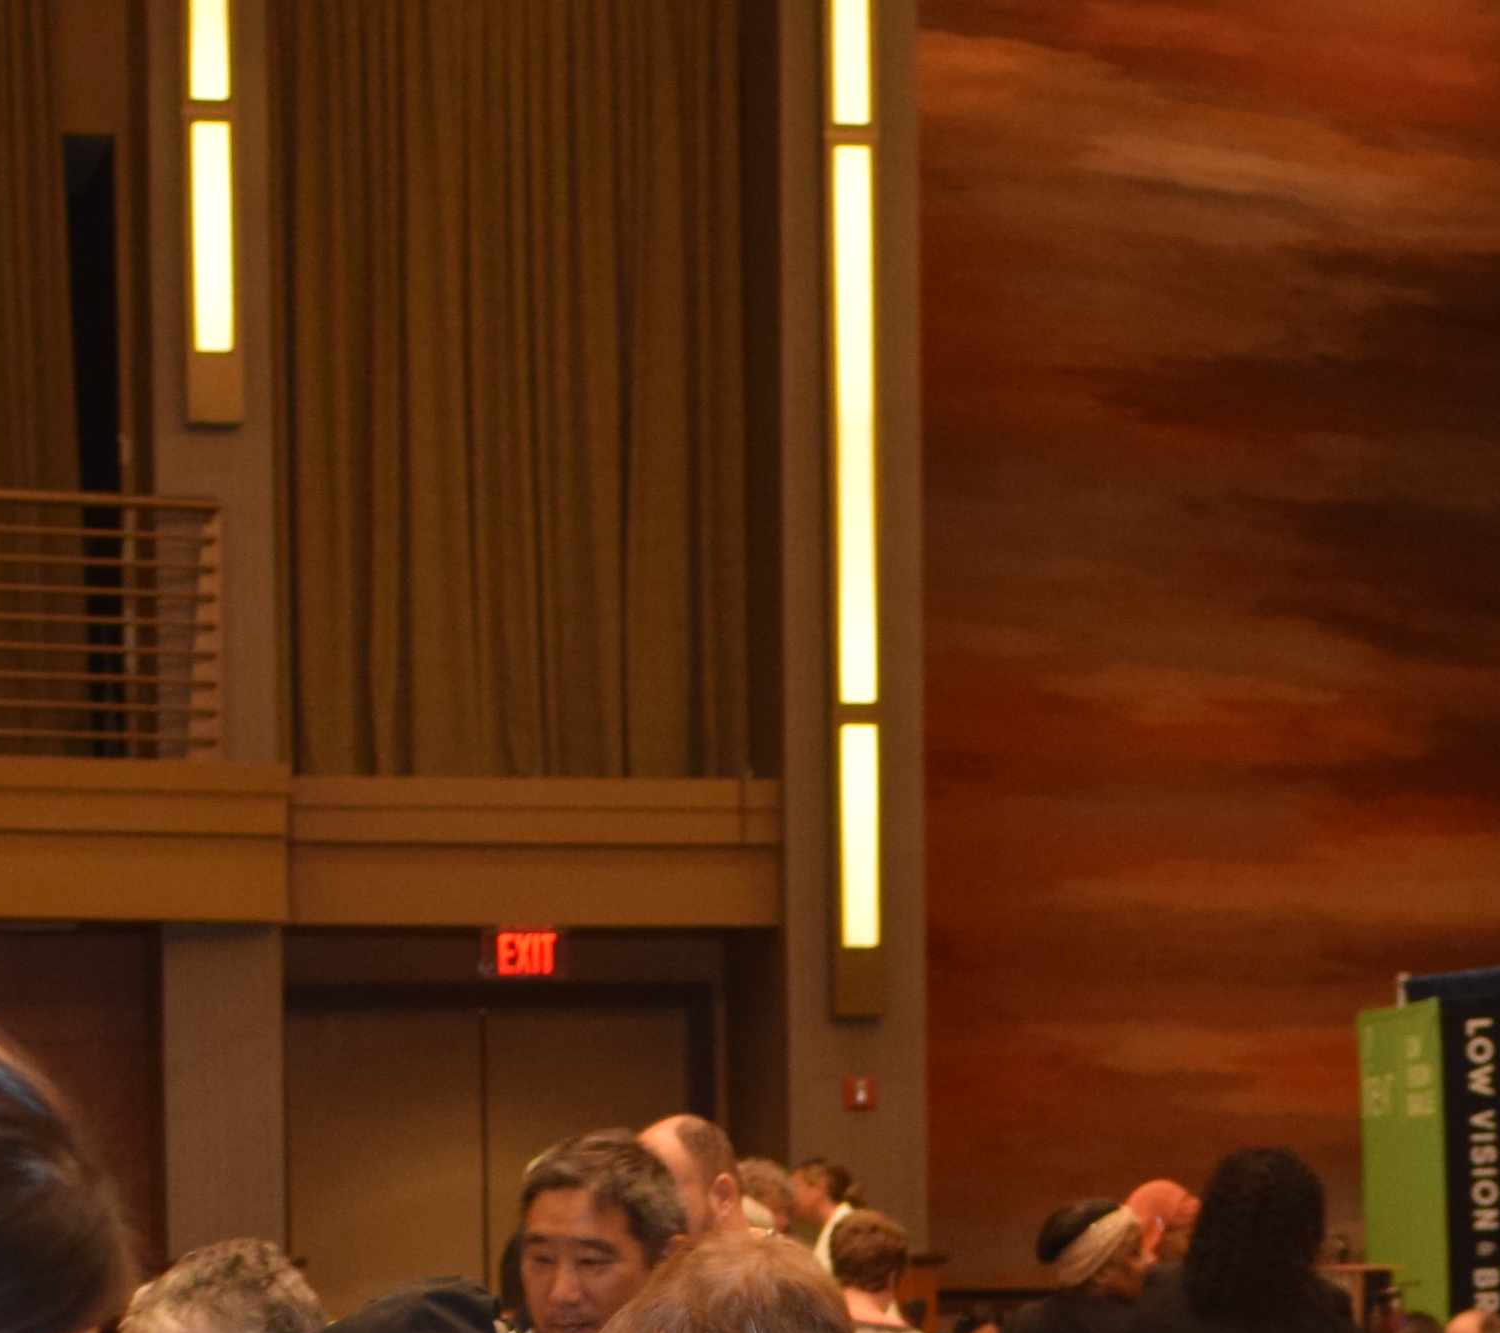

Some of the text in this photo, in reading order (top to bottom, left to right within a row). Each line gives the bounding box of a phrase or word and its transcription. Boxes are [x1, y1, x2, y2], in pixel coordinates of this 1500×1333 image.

[497, 932, 557, 974] EXIT
[1464, 1017, 1496, 1097] LOW
[1468, 1109, 1500, 1232] VISION
